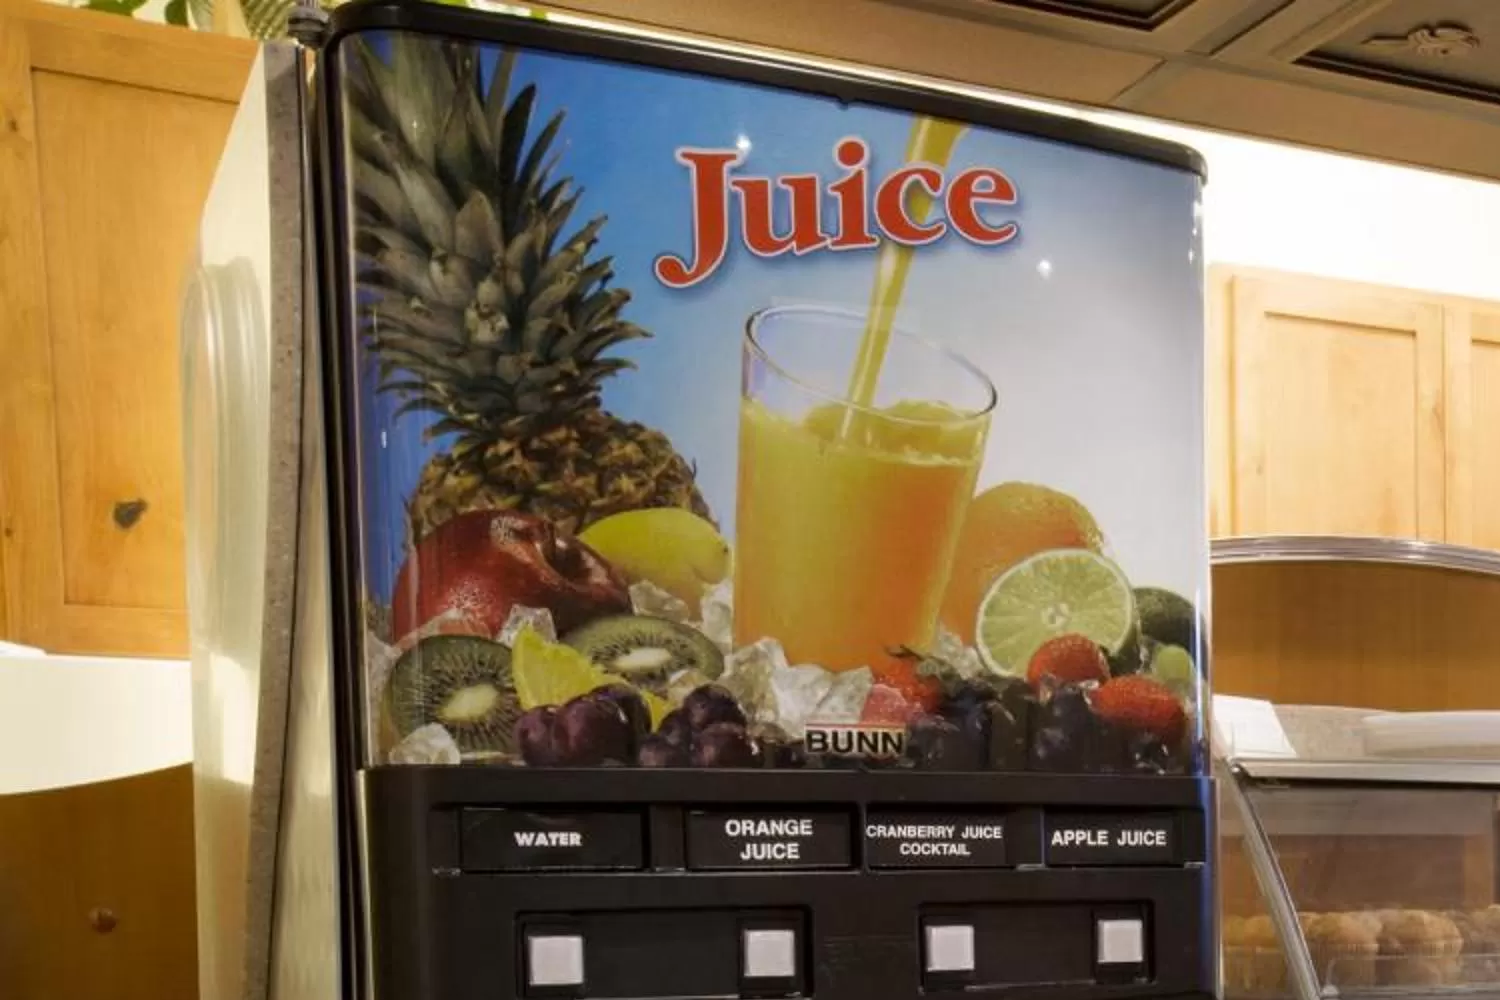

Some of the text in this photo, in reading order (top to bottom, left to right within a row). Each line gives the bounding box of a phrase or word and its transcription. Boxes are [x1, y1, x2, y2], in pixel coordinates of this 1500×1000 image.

[654, 136, 1019, 288] Juice
[805, 729, 903, 754] BUNN
[725, 819, 814, 837] ORANGE
[866, 825, 1003, 839] CRANBERRY JUICE
[513, 832, 582, 847] WATER
[1051, 830, 1166, 846] APPLE JUICE
[740, 843, 800, 860] JUICE
[899, 843, 971, 856] COCKTAIL
